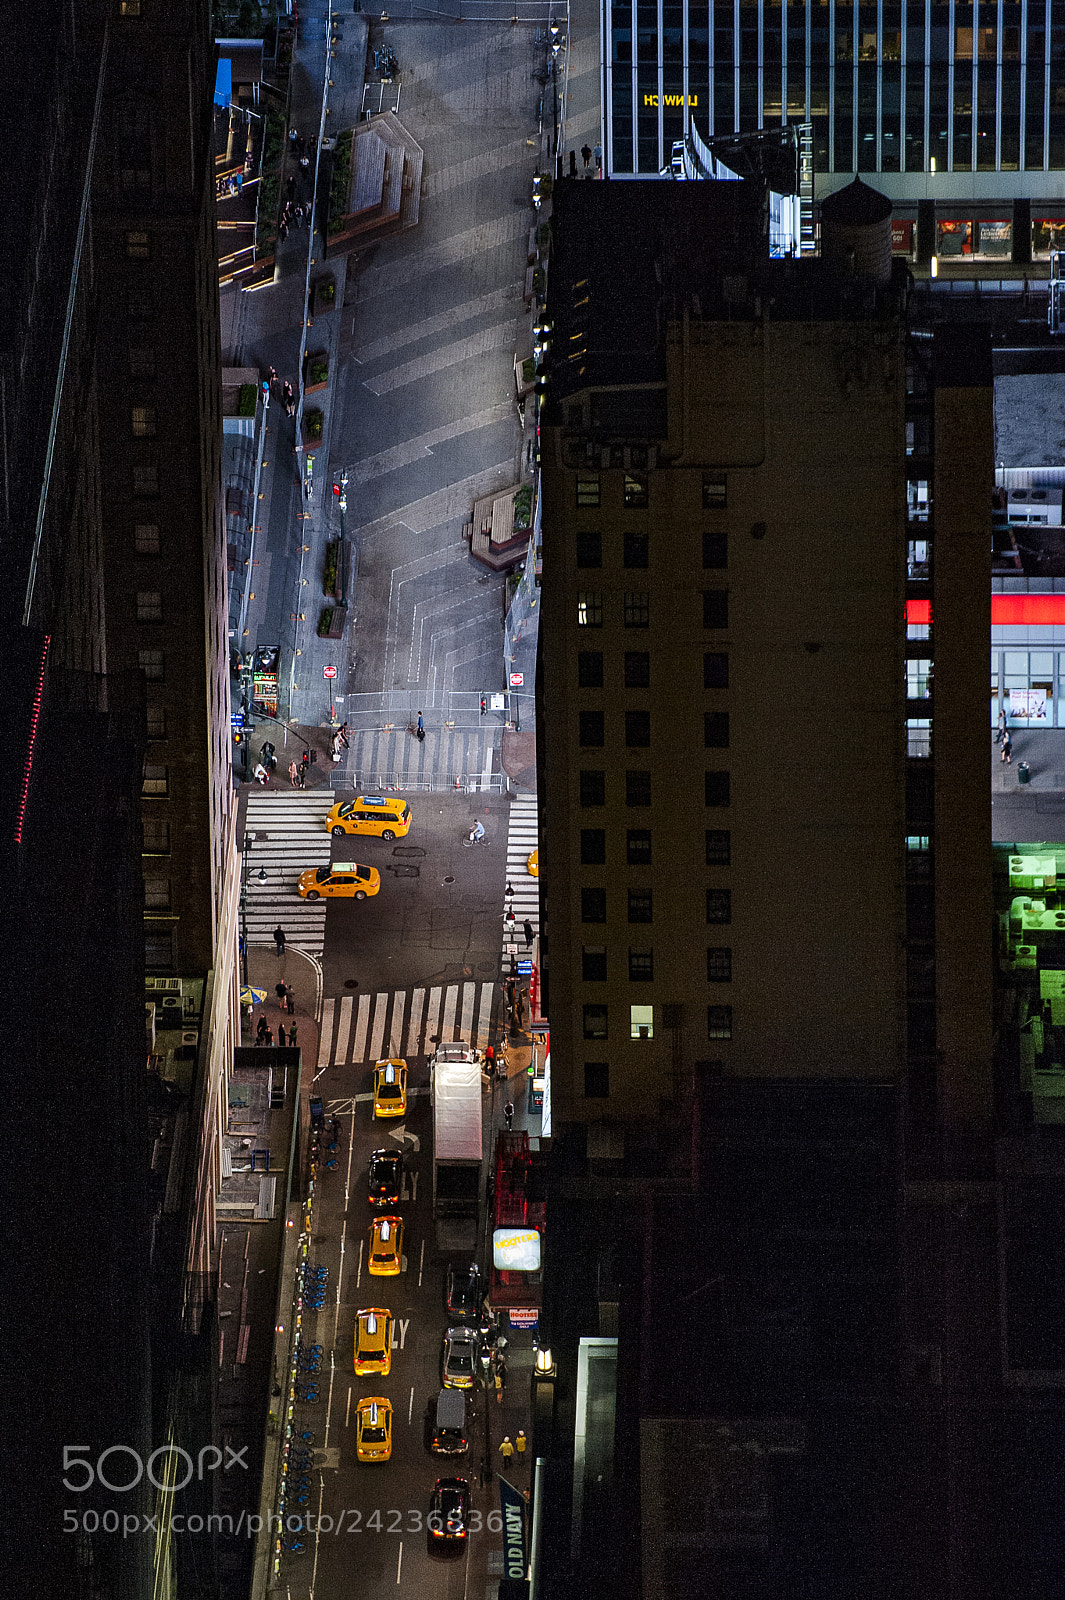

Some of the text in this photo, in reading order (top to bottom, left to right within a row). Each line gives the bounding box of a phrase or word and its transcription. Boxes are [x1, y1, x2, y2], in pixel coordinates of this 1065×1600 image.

[495, 1232, 539, 1250] HOOTERS
[505, 1503, 524, 1579] OLD NAVY
